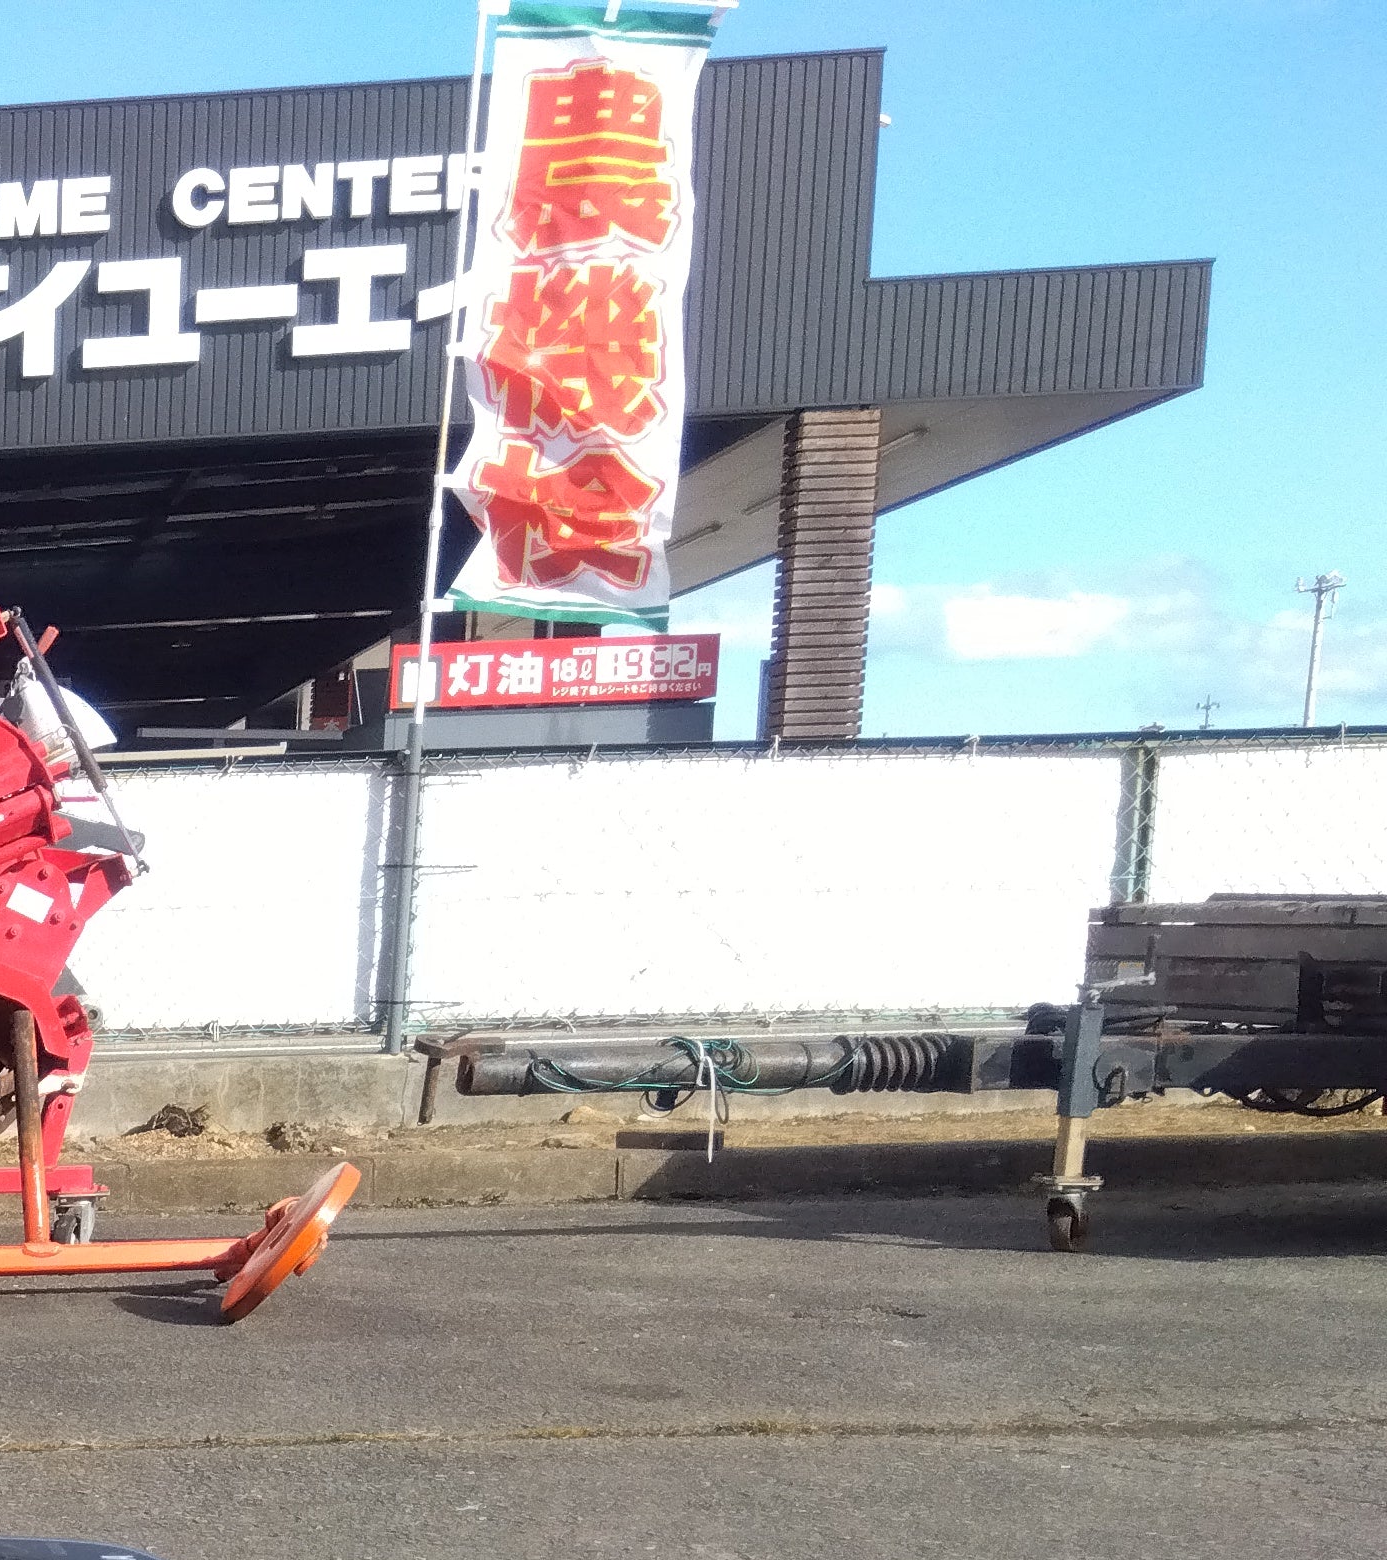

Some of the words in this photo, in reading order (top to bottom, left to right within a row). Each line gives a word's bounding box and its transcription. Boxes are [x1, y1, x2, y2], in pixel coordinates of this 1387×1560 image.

[477, 64, 673, 585] 農機検
[447, 651, 544, 697] 灯油
